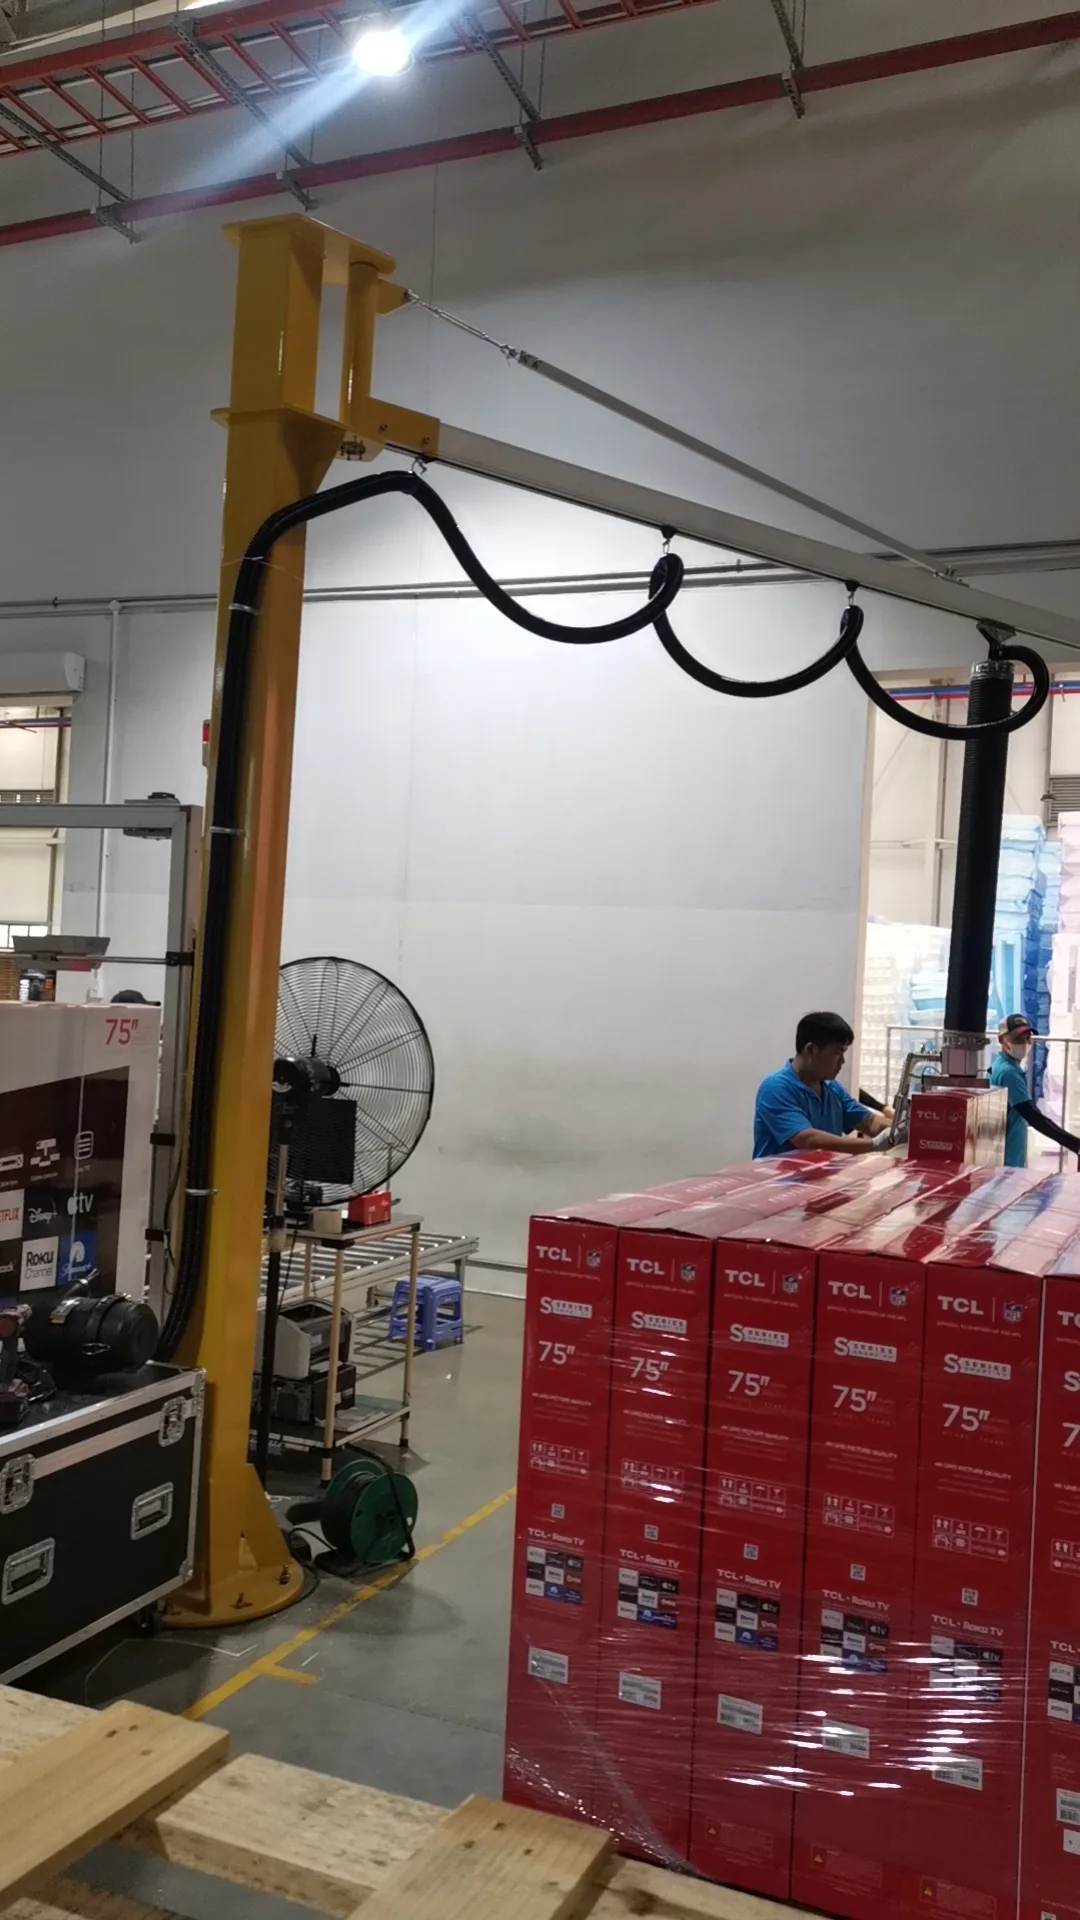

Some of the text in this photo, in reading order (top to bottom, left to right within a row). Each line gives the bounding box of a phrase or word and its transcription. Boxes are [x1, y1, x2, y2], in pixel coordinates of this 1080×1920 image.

[105, 1018, 140, 1045] 75"
[916, 1110, 940, 1120] TCL
[26, 1251, 54, 1267] Roku
[535, 1245, 572, 1262] TCL
[626, 1258, 665, 1275] TCL
[724, 1269, 766, 1287] TCL
[828, 1281, 872, 1299] TCL
[937, 1295, 984, 1315] TCL
[538, 1340, 576, 1365] 75"
[630, 1356, 670, 1381] 75"
[728, 1370, 770, 1396] 75"
[832, 1384, 877, 1412] 75"
[942, 1403, 990, 1432] 75"
[527, 1527, 547, 1539] TCL
[573, 1537, 585, 1546] TV
[619, 1549, 641, 1560] TCL
[668, 1559, 680, 1568] TV
[717, 1568, 739, 1581] TCL
[768, 1579, 782, 1589] TV
[822, 1589, 845, 1602] TCL
[876, 1601, 890, 1612] TV
[931, 1614, 956, 1627] TCL
[990, 1626, 1004, 1637] TV
[1050, 1640, 1076, 1654] TCL
